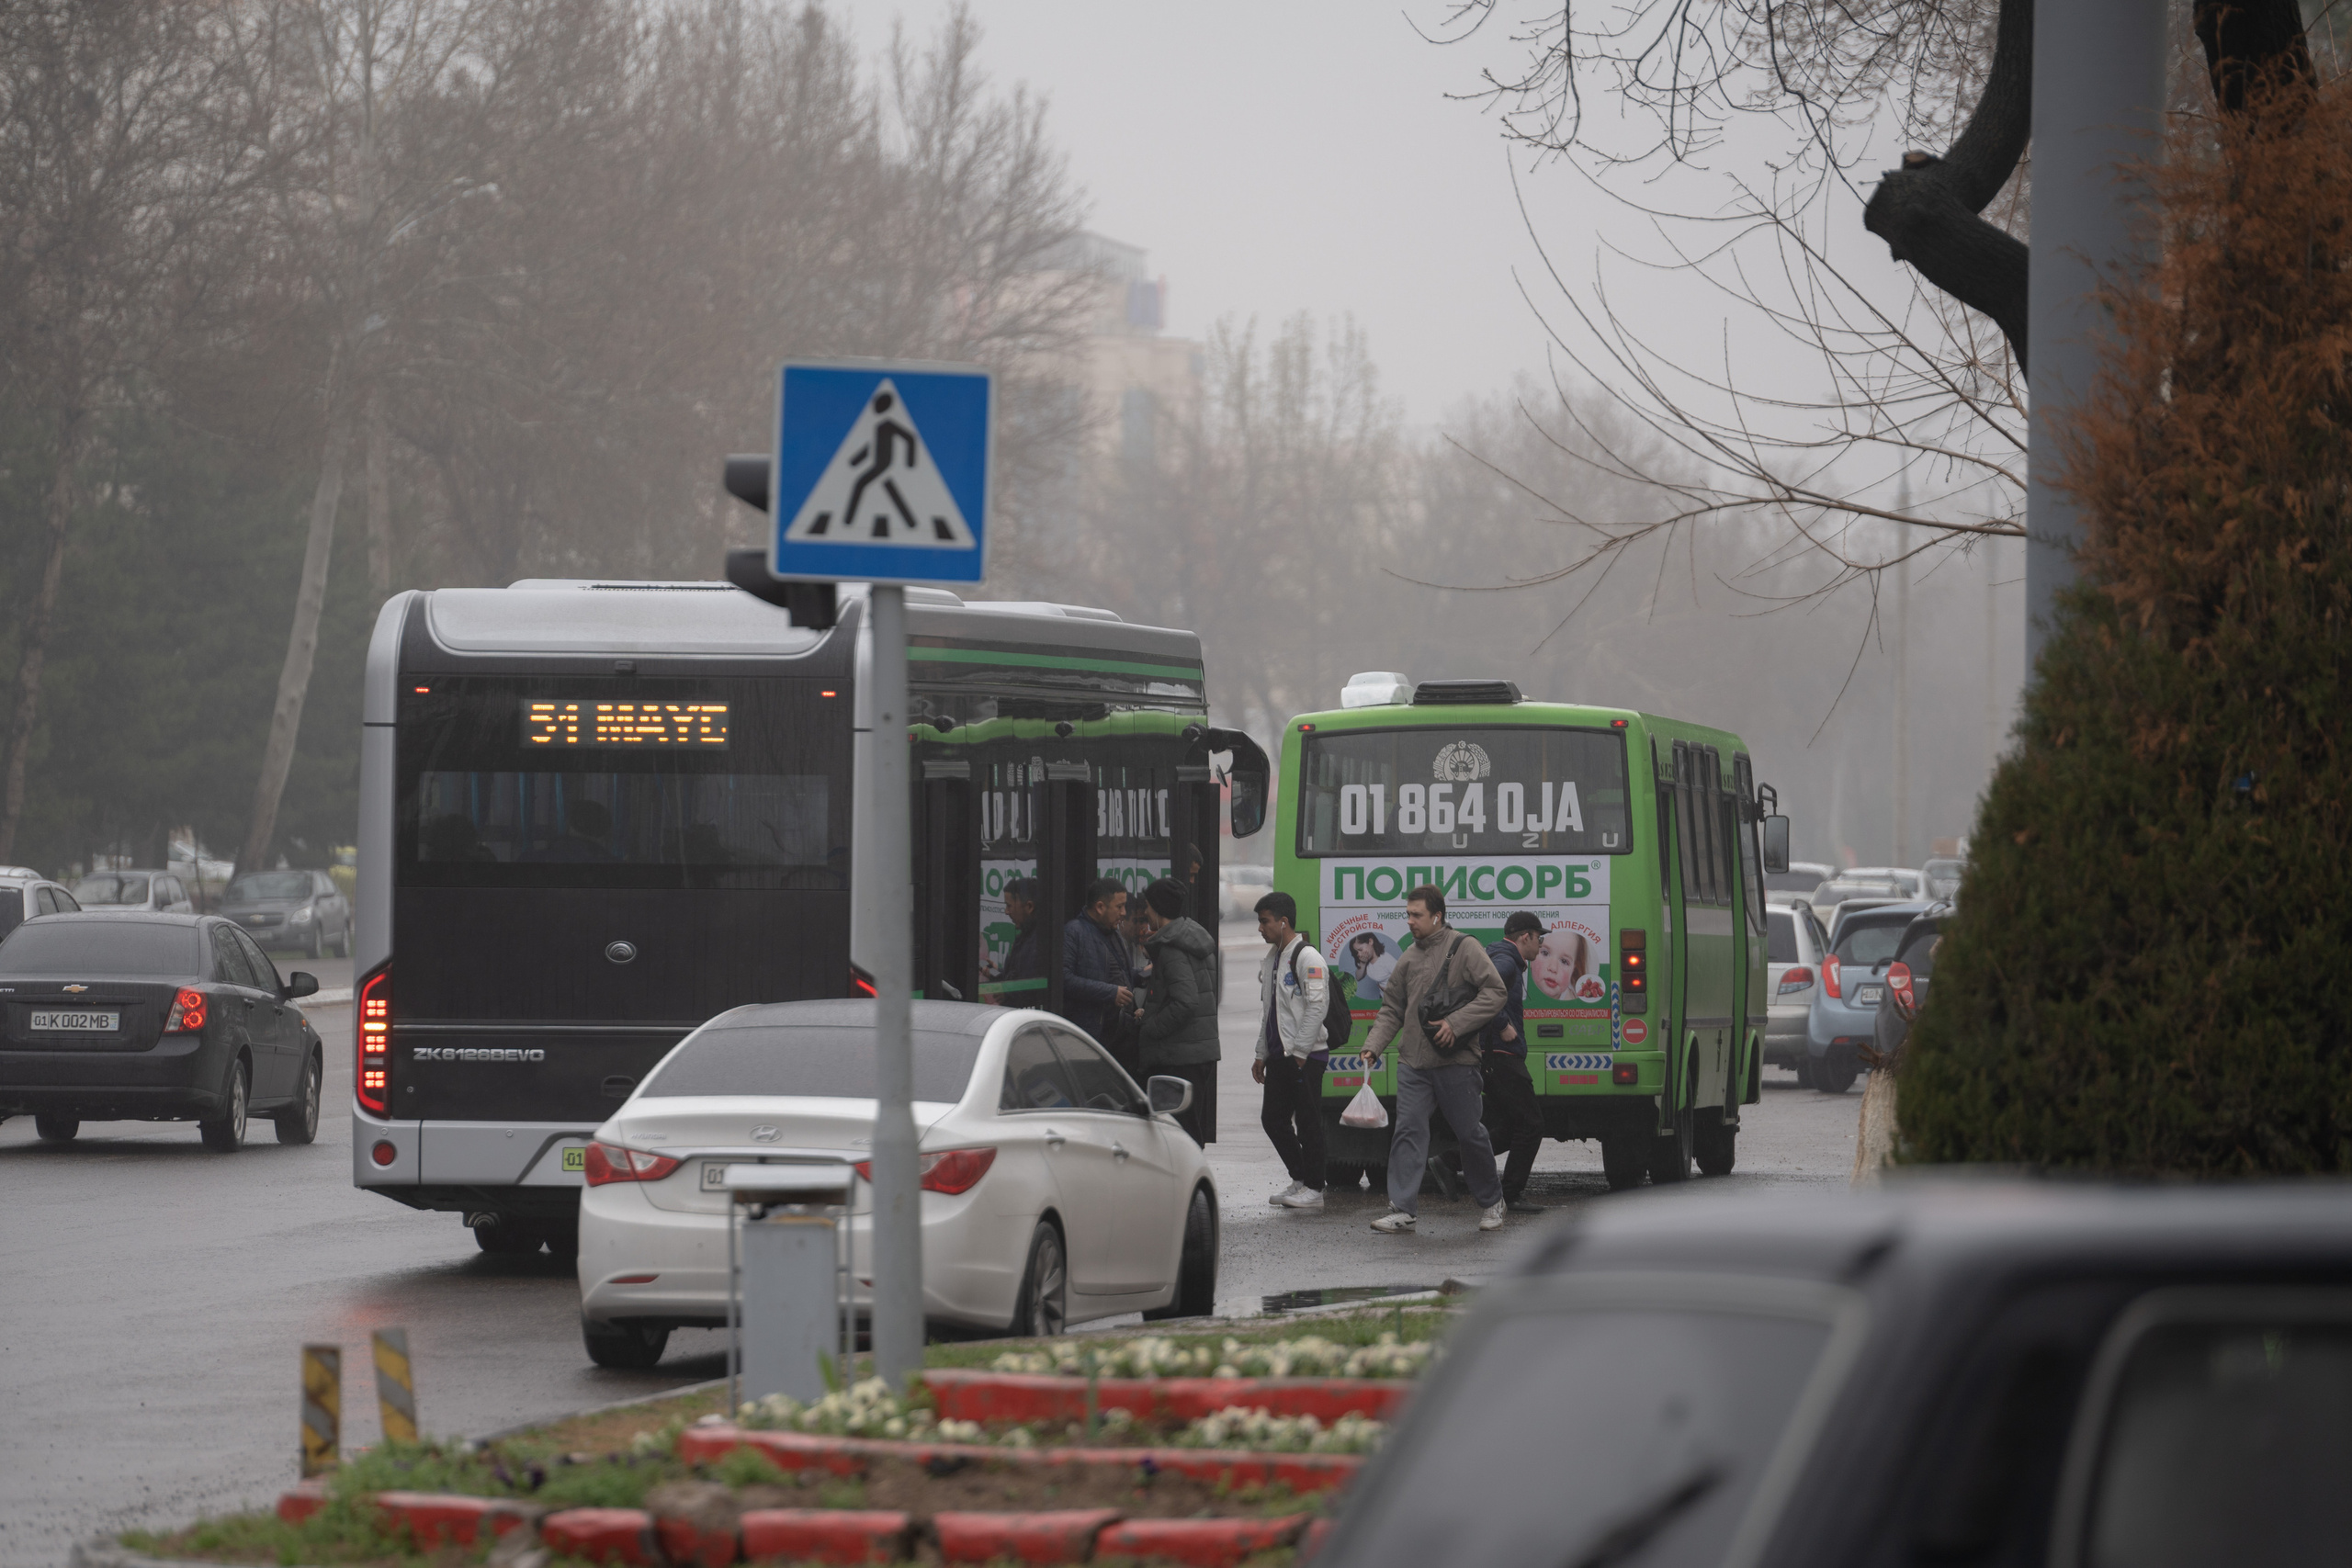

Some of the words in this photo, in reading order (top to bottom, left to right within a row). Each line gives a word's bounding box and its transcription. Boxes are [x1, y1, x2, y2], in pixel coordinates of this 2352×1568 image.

[1340, 784, 1385, 834] 01
[1398, 782, 1487, 833] 864
[1445, 910, 1491, 919] ТЕРОСОРБЕНТ
[1326, 913, 1369, 944] КИШЕЧНЫЕ
[1551, 920, 1601, 944] АЛЛЕРГИЯ
[1329, 921, 1385, 959] РАССТРОЙСТВА
[34, 1015, 48, 1027] 01
[1523, 1010, 1568, 1018] ОКОНСУЛЬТИРОВАТЬСЯ
[566, 1152, 583, 1167] 01
